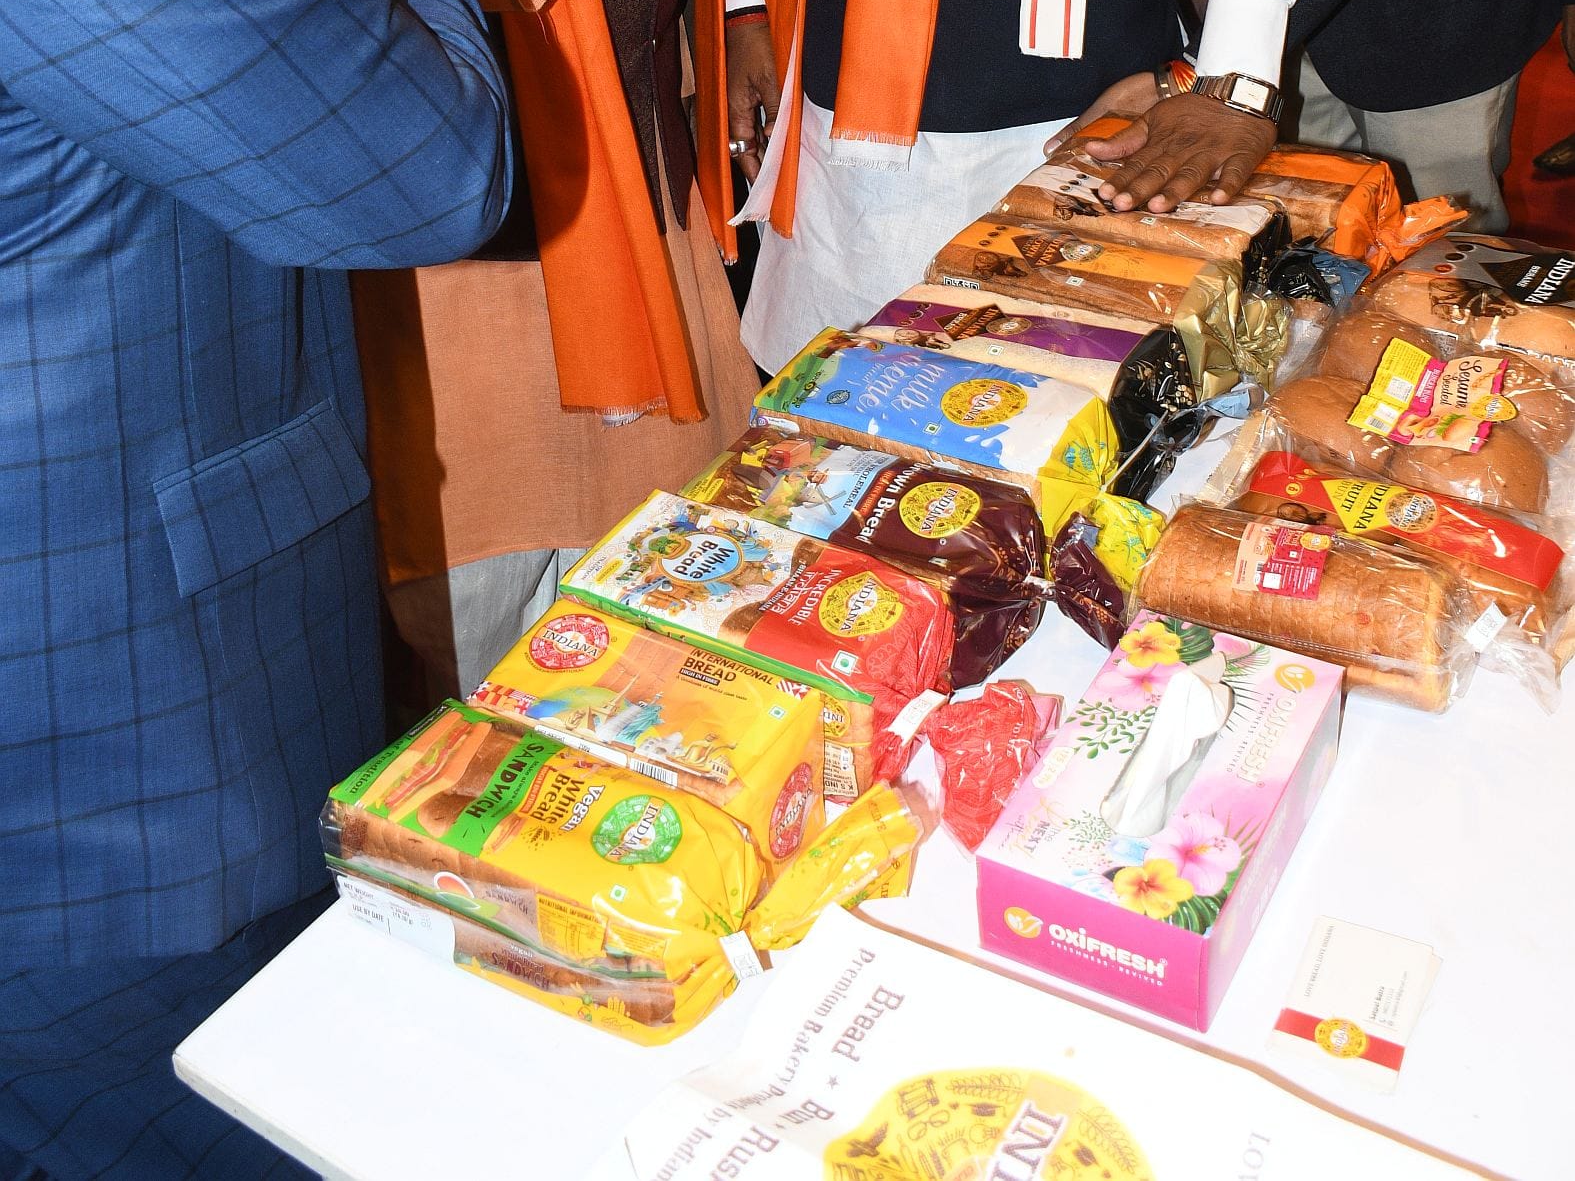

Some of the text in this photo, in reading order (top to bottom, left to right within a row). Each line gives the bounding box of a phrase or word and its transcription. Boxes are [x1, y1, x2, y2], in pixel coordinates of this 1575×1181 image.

[1525, 258, 1575, 304] INDIANA
[963, 384, 1003, 422] INDIANA
[1455, 359, 1483, 410] Sesame
[853, 496, 897, 545] Bread
[920, 486, 959, 532] INDIANA
[672, 539, 719, 578] Bread
[689, 546, 735, 580] White
[787, 568, 843, 626] INCREDIBLE
[840, 577, 878, 632] INDIANA
[542, 629, 600, 657] INDIANA
[683, 656, 738, 683] BREAD
[690, 648, 774, 686] INTERNATIONAL
[465, 742, 545, 820] SANDWICH
[530, 773, 572, 823] Bread
[547, 778, 586, 825] White
[560, 785, 606, 833] Vegan
[609, 805, 659, 858] INDIANA
[1024, 820, 1051, 853] NEXT
[814, 947, 877, 1019] Premium
[1118, 966, 1164, 987] REVIVED
[831, 985, 906, 1063] Bread
[782, 1020, 824, 1087] Bakery
[711, 1106, 732, 1128] by
